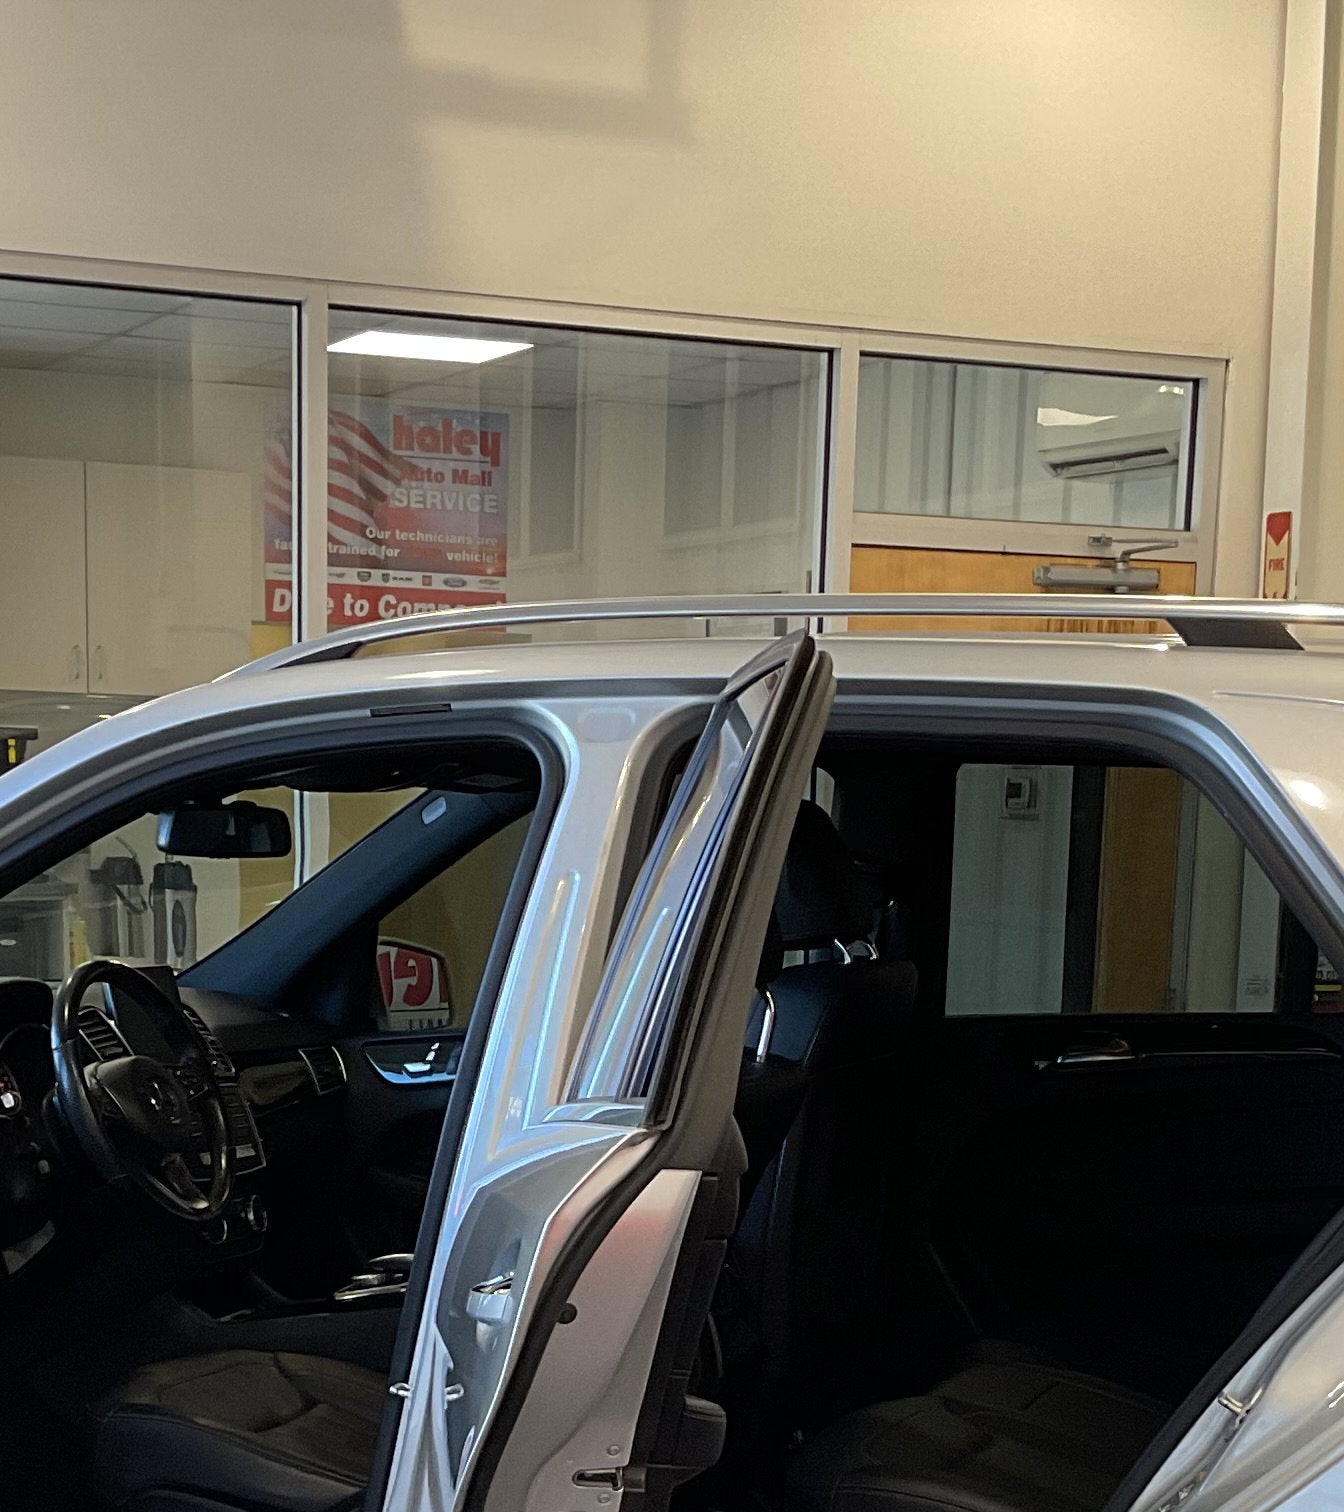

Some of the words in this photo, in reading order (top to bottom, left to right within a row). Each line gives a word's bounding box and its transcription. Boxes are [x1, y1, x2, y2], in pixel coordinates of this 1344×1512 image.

[393, 414, 501, 467] haley
[400, 466, 445, 483] Auto
[451, 468, 492, 487] Mall
[393, 487, 498, 513] SERVICE
[366, 527, 391, 540] Our
[395, 529, 472, 545] technicians
[381, 545, 400, 558] for
[446, 551, 498, 564] vehicle!
[343, 593, 369, 617] to
